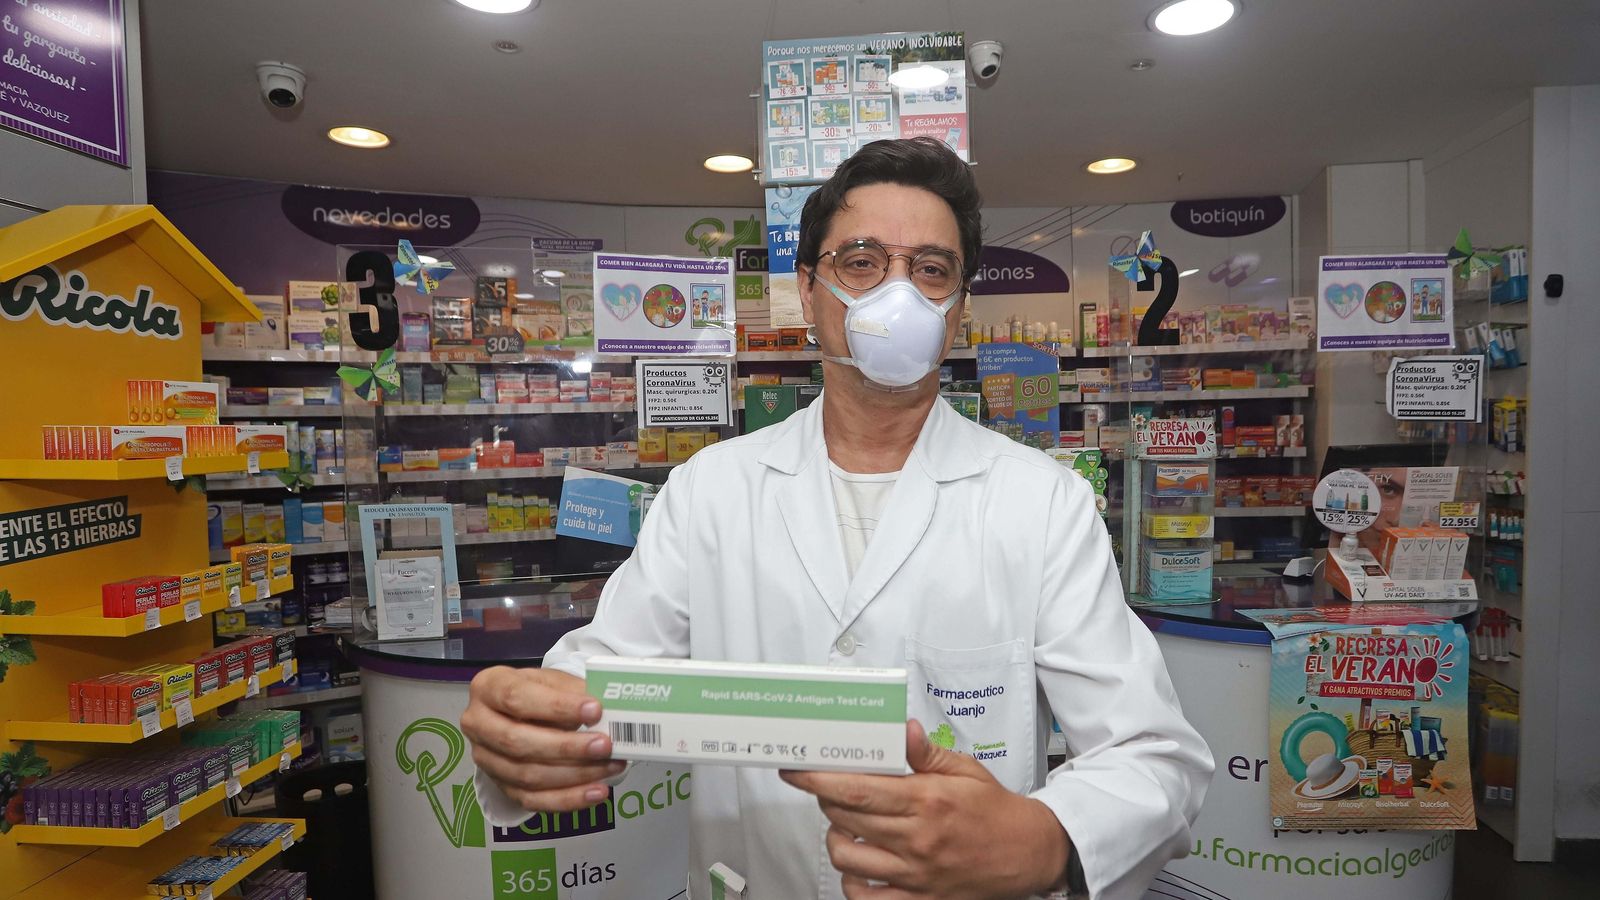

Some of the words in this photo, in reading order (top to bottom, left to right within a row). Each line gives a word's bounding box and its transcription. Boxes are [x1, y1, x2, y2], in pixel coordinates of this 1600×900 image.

[33, 3, 92, 36] ansiedad
[3, 15, 19, 35] tu
[23, 30, 86, 65] garganta
[767, 45, 794, 57] Porque
[797, 46, 811, 55] nos
[813, 43, 855, 54] merecemos
[857, 43, 867, 51] un
[869, 37, 905, 51] VERANO
[909, 35, 962, 50] INOLVIDABLE
[2, 48, 76, 91] deliciosos!
[10, 95, 17, 104] Y
[20, 98, 70, 124] VAZQUEZ
[914, 117, 958, 127] REGALAMOS
[313, 206, 451, 229] novedades
[1189, 205, 1265, 226] botiquín
[770, 231, 782, 243] Te
[776, 248, 793, 257] una
[635, 260, 665, 269] ALARGARÁ
[739, 283, 762, 296] 365
[0, 264, 181, 338] Ricola
[346, 251, 400, 351] 3
[1137, 256, 1180, 346] 2
[657, 344, 677, 352] equipo
[685, 343, 728, 351] Nutricionistas?
[1377, 338, 1396, 347] equipo
[1404, 337, 1447, 345] Nutricionistas?
[992, 348, 1017, 356] compra
[1003, 356, 1034, 364] productos
[646, 369, 688, 377] Productos
[1395, 375, 1445, 383] CoronaVirus
[646, 379, 696, 387] CoronaVirus
[1020, 376, 1053, 398] 60
[762, 391, 778, 400] Relec
[1149, 421, 1190, 432] REGRESA
[1136, 432, 1148, 443] EL
[1149, 430, 1207, 446] VERANO
[46, 509, 67, 530] EL
[70, 501, 125, 527] EFECTO
[565, 500, 598, 518] Protege
[598, 508, 605, 520] y
[1322, 512, 1344, 523] 15%
[1347, 514, 1370, 525] 25%
[1441, 517, 1477, 527] 22.95€
[562, 516, 587, 531] cuida
[586, 519, 597, 532] tu
[597, 521, 614, 535] piel
[13, 536, 47, 559] LAS
[50, 531, 70, 552] 13
[74, 519, 136, 547] HIERBAS
[247, 552, 268, 566] Ricola
[271, 551, 290, 560] Ricola
[204, 571, 221, 580] Ricola
[225, 566, 241, 574] Ricola
[160, 580, 180, 590] Ricola
[183, 576, 200, 585] Ricola
[135, 586, 157, 596] Ricola
[161, 588, 180, 599] PERLAS
[135, 595, 157, 604] PERLAS
[250, 642, 273, 657] Ricola
[1335, 637, 1409, 657] REGRESA
[225, 650, 248, 665] Ricola
[197, 659, 222, 675] Ricola
[1304, 654, 1327, 674] EL
[1331, 655, 1438, 684] VERANO
[167, 672, 193, 685] Ricola
[132, 683, 161, 699] Ricola
[603, 682, 672, 700] BOSON
[926, 683, 1005, 700] Farmaceutico
[1323, 685, 1329, 694] Y
[1328, 686, 1346, 695] GANA
[1346, 686, 1383, 696] ATRACTIVOS
[1383, 687, 1412, 698] PREMIOS
[701, 690, 729, 701] Rapid
[732, 691, 793, 703] SARS-CoV-2
[795, 694, 834, 706] Antigen
[836, 696, 858, 706] Test
[859, 696, 885, 707] Card
[946, 705, 986, 718] Juanjo
[819, 746, 885, 761] COVID-19
[972, 749, 1008, 761] Vázquez
[204, 753, 229, 771] Ricola
[173, 767, 201, 786] Ricola
[142, 781, 169, 801] Ricola
[501, 868, 553, 894] 365
[560, 861, 617, 889] días
